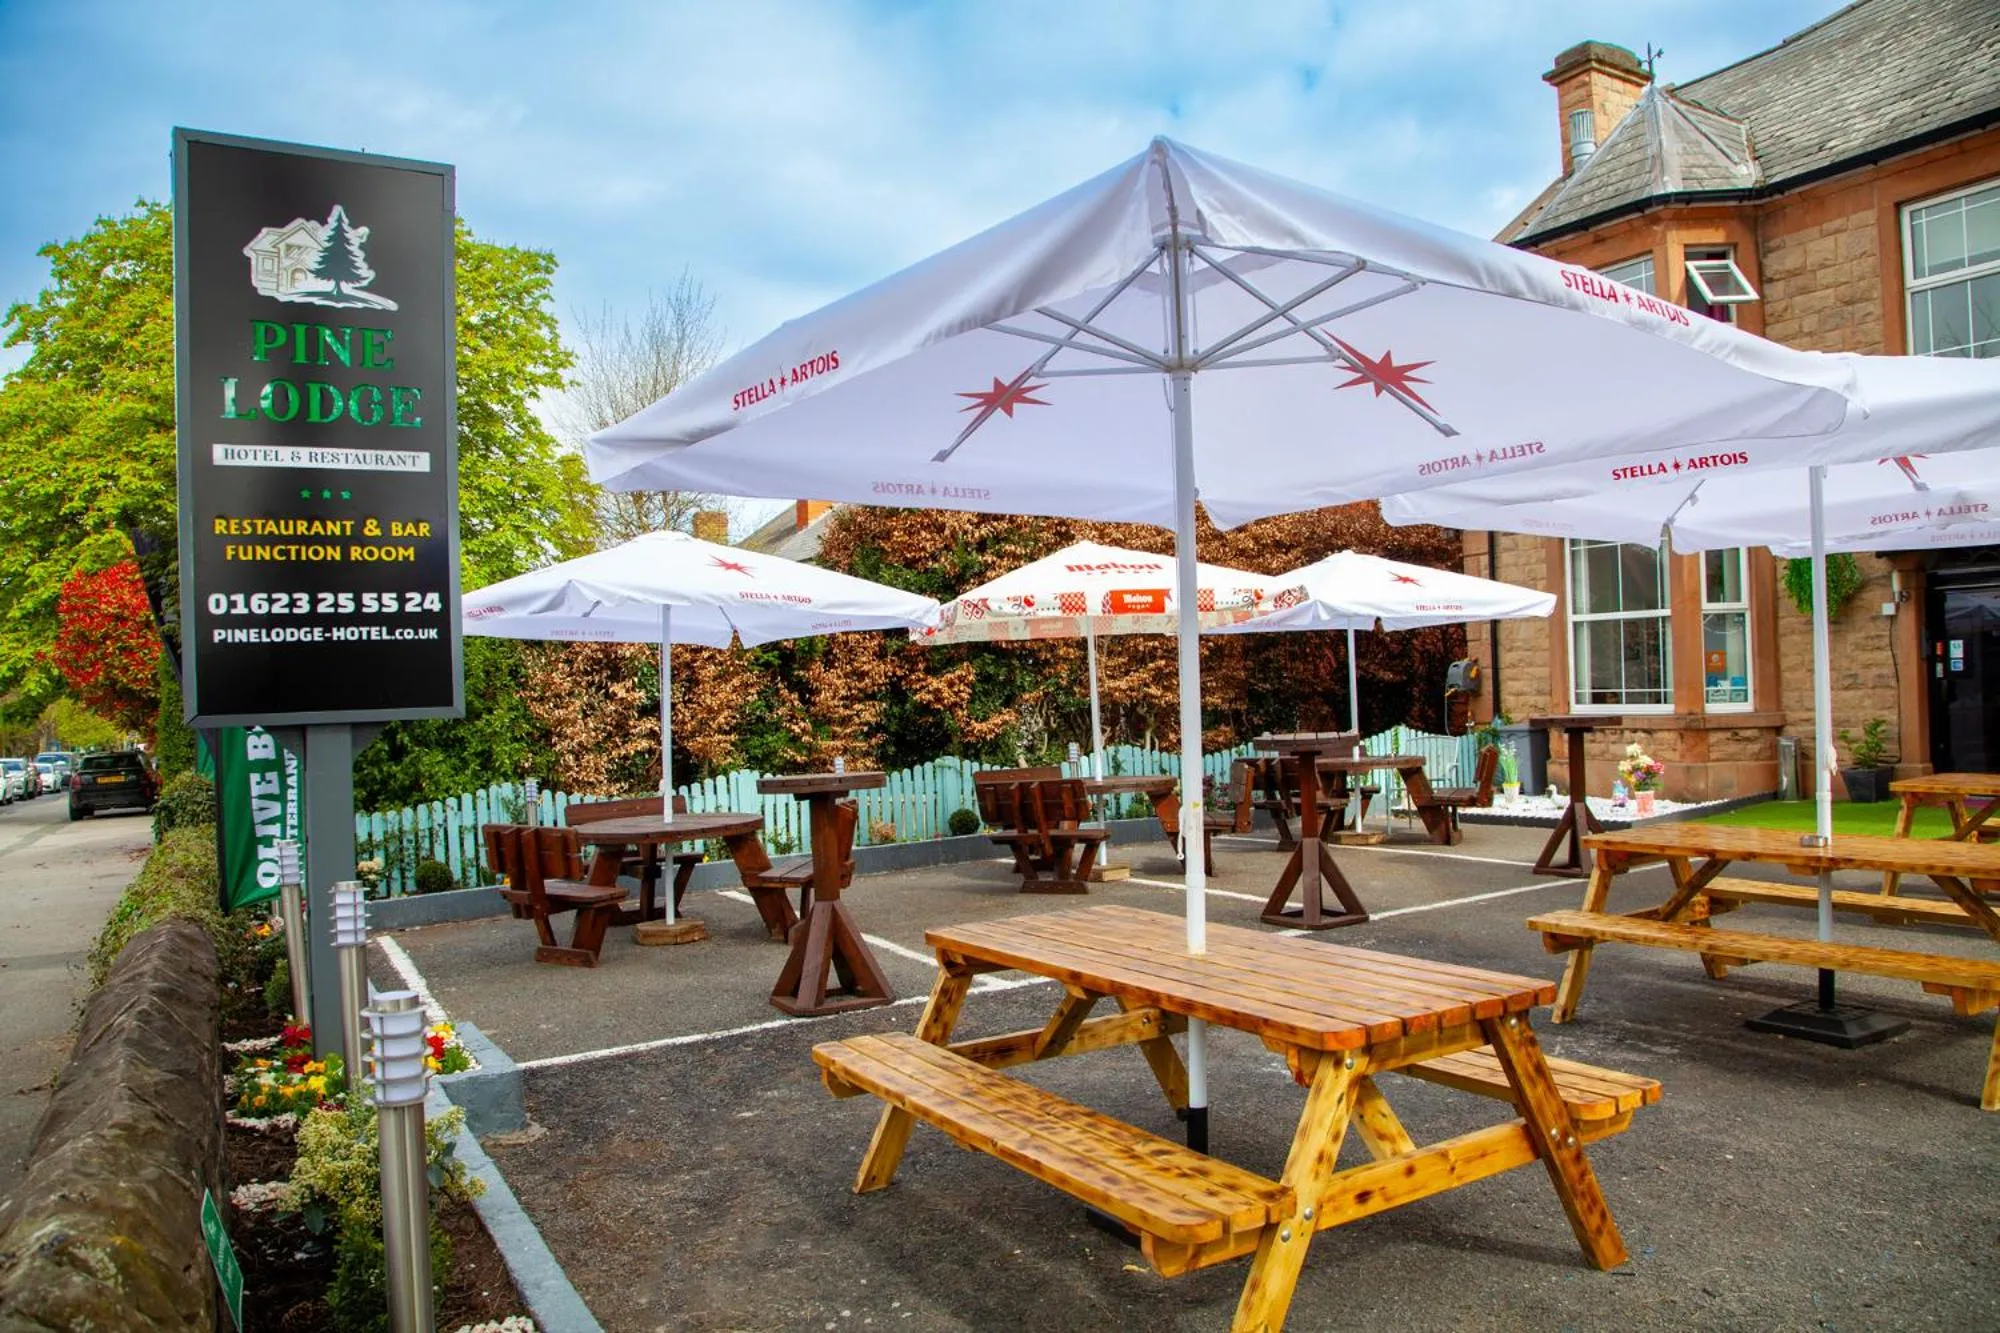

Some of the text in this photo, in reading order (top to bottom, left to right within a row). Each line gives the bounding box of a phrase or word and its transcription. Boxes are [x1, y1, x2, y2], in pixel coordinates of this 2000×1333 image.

[1560, 269, 1690, 326] STELLA ARTOIS
[249, 319, 395, 371] PINE
[733, 350, 839, 411] STELLA ARTOIS
[219, 376, 424, 429] LODGE
[223, 447, 420, 468] HOTEL & RESTAURANT
[1612, 451, 1749, 480] STELLA ARTOIS
[213, 517, 431, 537] RESTAURANT & BAR
[225, 544, 416, 562] FUNCTION ROOM
[207, 592, 311, 616] 01623
[316, 591, 355, 614] 25
[361, 592, 399, 613] 55
[404, 591, 442, 613] 24
[250, 771, 282, 889] OLIVE
